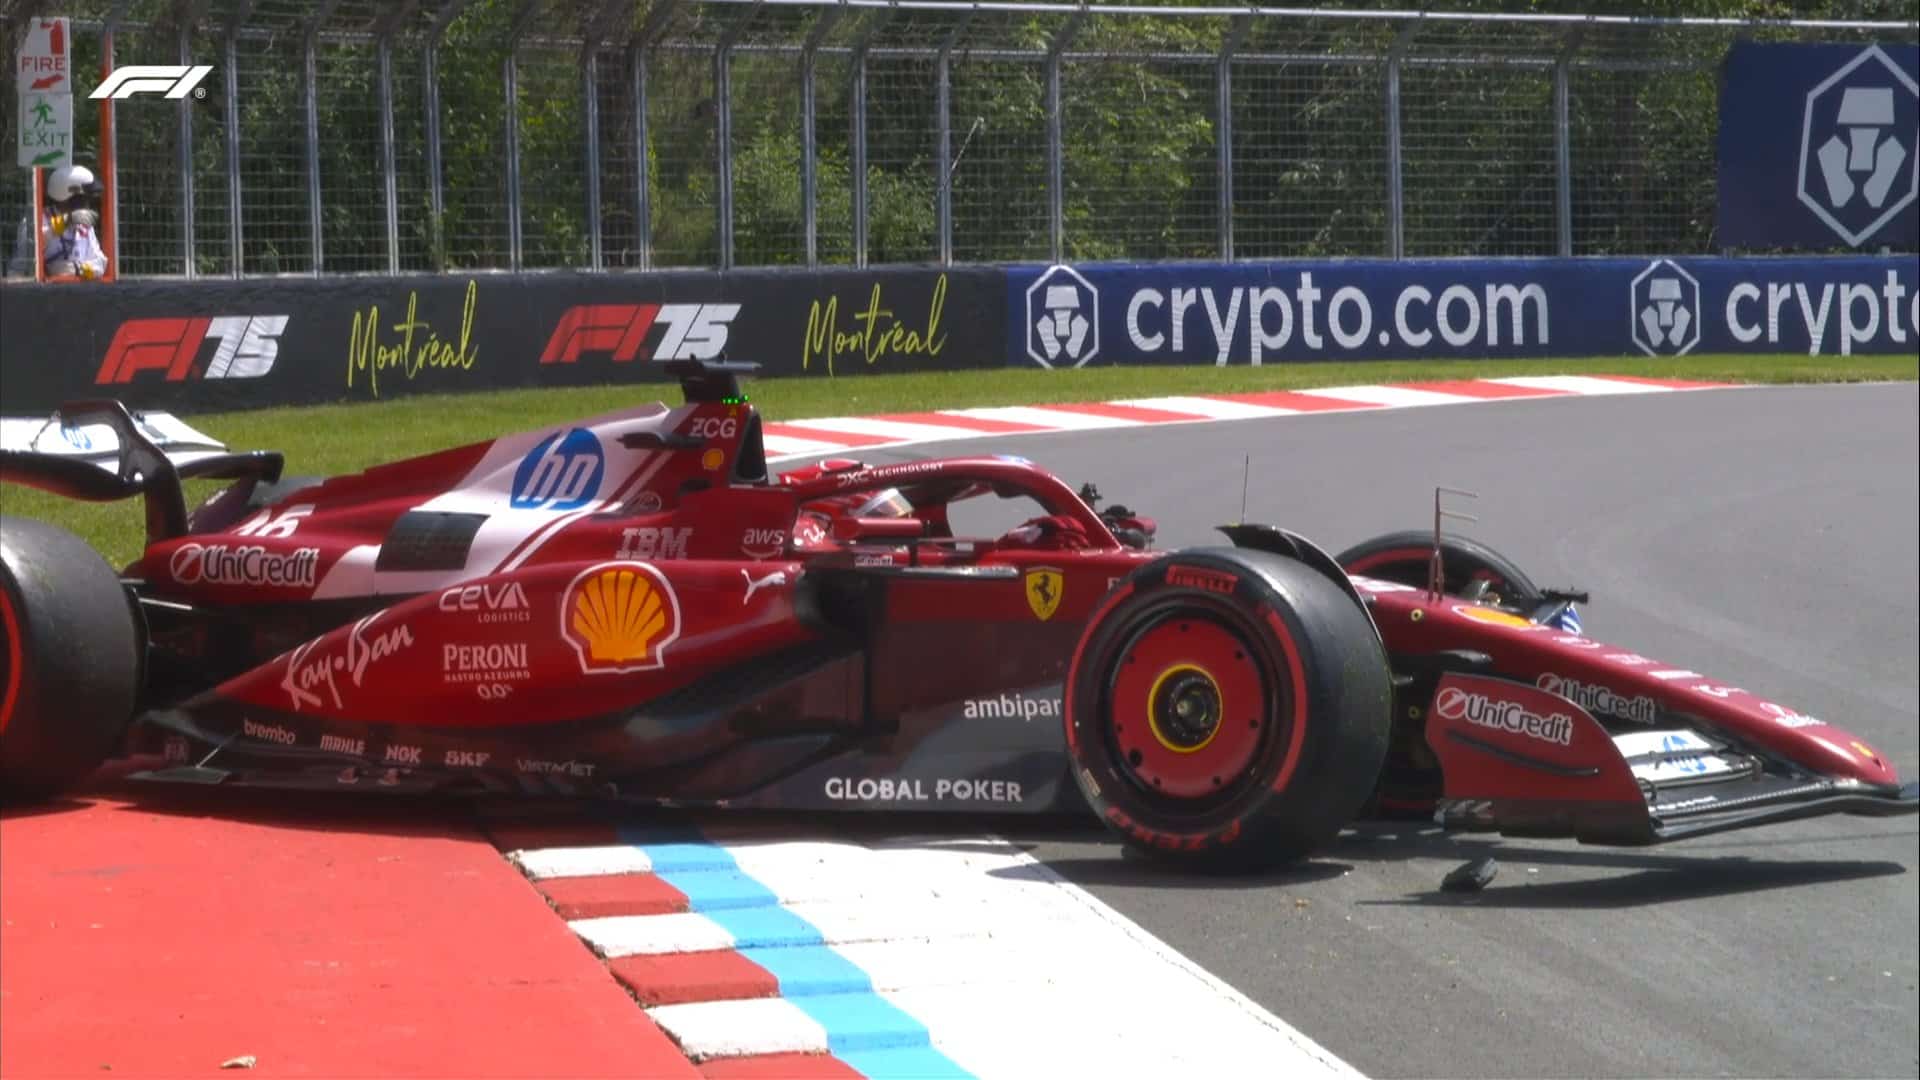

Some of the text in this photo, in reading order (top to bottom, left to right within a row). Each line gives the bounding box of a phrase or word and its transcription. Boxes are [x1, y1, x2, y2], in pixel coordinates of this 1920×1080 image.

[21, 56, 65, 72] FIRE
[22, 132, 69, 146] EXIT
[803, 273, 948, 376] Montréal
[1126, 271, 1549, 367] crypto.com
[1725, 269, 1919, 356] crypt
[347, 279, 480, 398] Montréal
[689, 417, 737, 438] ZCG
[510, 427, 605, 511] hp
[872, 461, 944, 477] TECHNOLOGY
[615, 527, 694, 560] IBM
[743, 528, 784, 545] aws
[203, 544, 320, 587] UniCredit
[1166, 564, 1238, 593] PIRELLI
[478, 611, 530, 622] LOGISTICS
[443, 643, 528, 670] PERONI
[964, 694, 1061, 720] ambipar
[1556, 677, 1656, 724] UniCredit
[243, 719, 296, 745] brembo
[1466, 694, 1572, 745] UniCredit
[320, 734, 366, 755] MAHLE
[386, 744, 422, 764] NGK
[445, 750, 491, 767] SKF
[825, 777, 1023, 802] GLOBAL POKER
